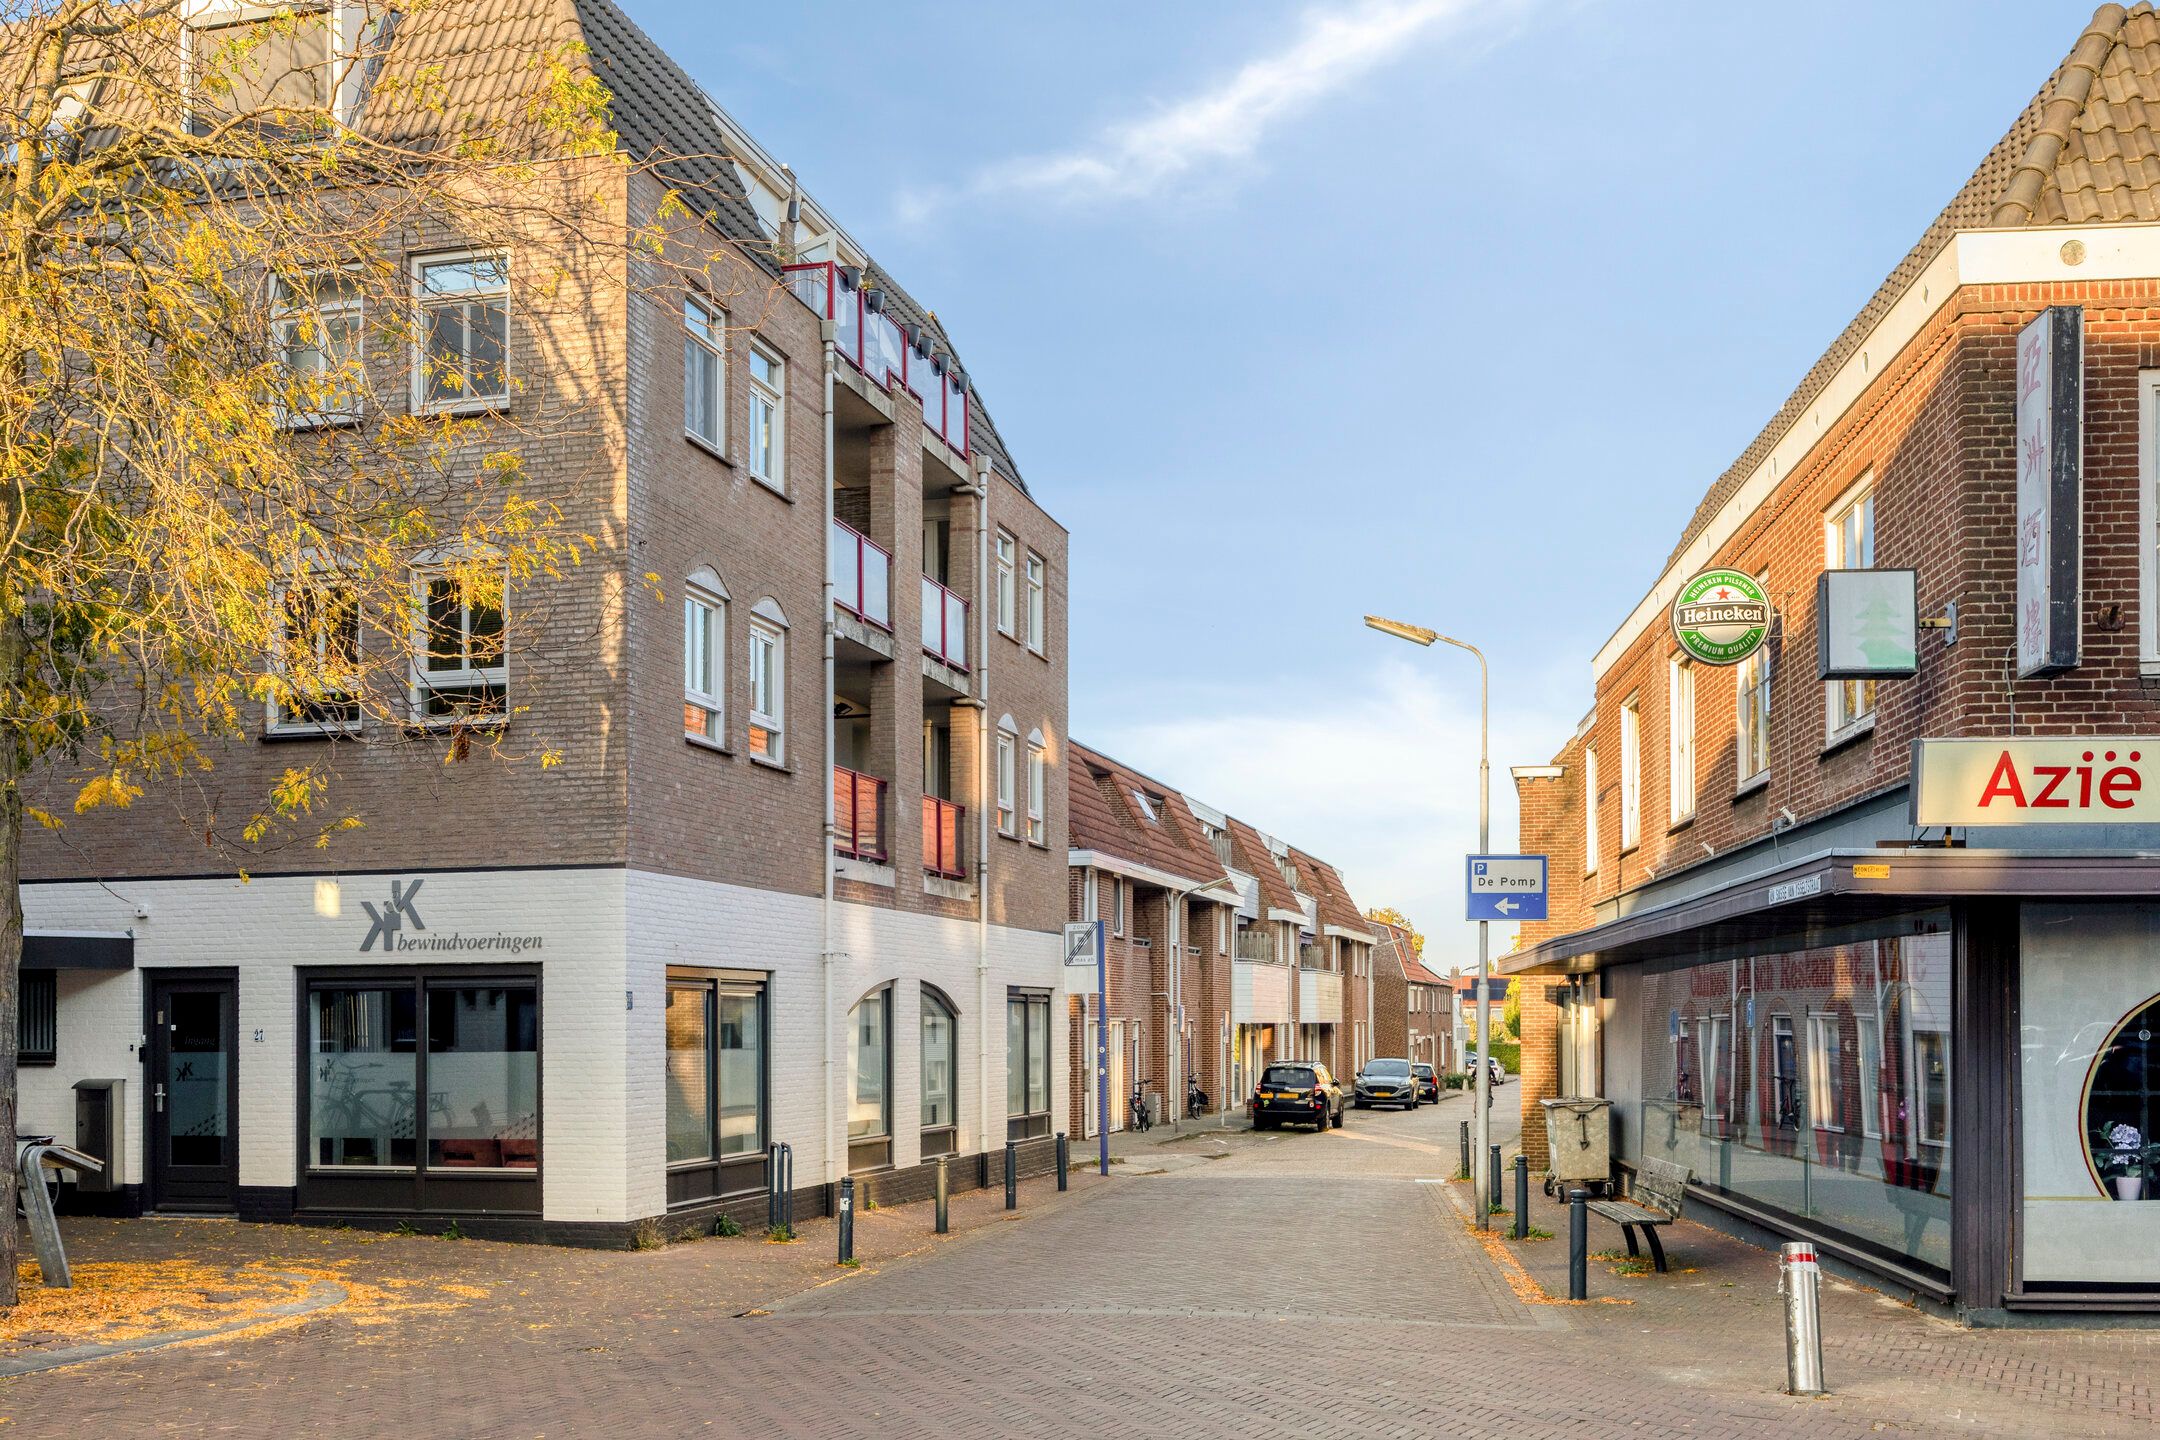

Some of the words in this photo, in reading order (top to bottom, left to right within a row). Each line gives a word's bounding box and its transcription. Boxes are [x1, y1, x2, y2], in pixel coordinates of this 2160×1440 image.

[1690, 577, 1722, 598] HEINEKEN
[1724, 576, 1755, 595] PILSENER
[1683, 606, 1763, 623] Heineken
[1690, 634, 1724, 655] PREMIUM
[1727, 631, 1757, 654] QUALITY
[1977, 750, 2142, 809] Azië
[1478, 877, 1494, 887] De
[1500, 877, 1536, 888] Pomp
[397, 932, 543, 953] bewindvoeringen
[254, 1028, 265, 1042] 27
